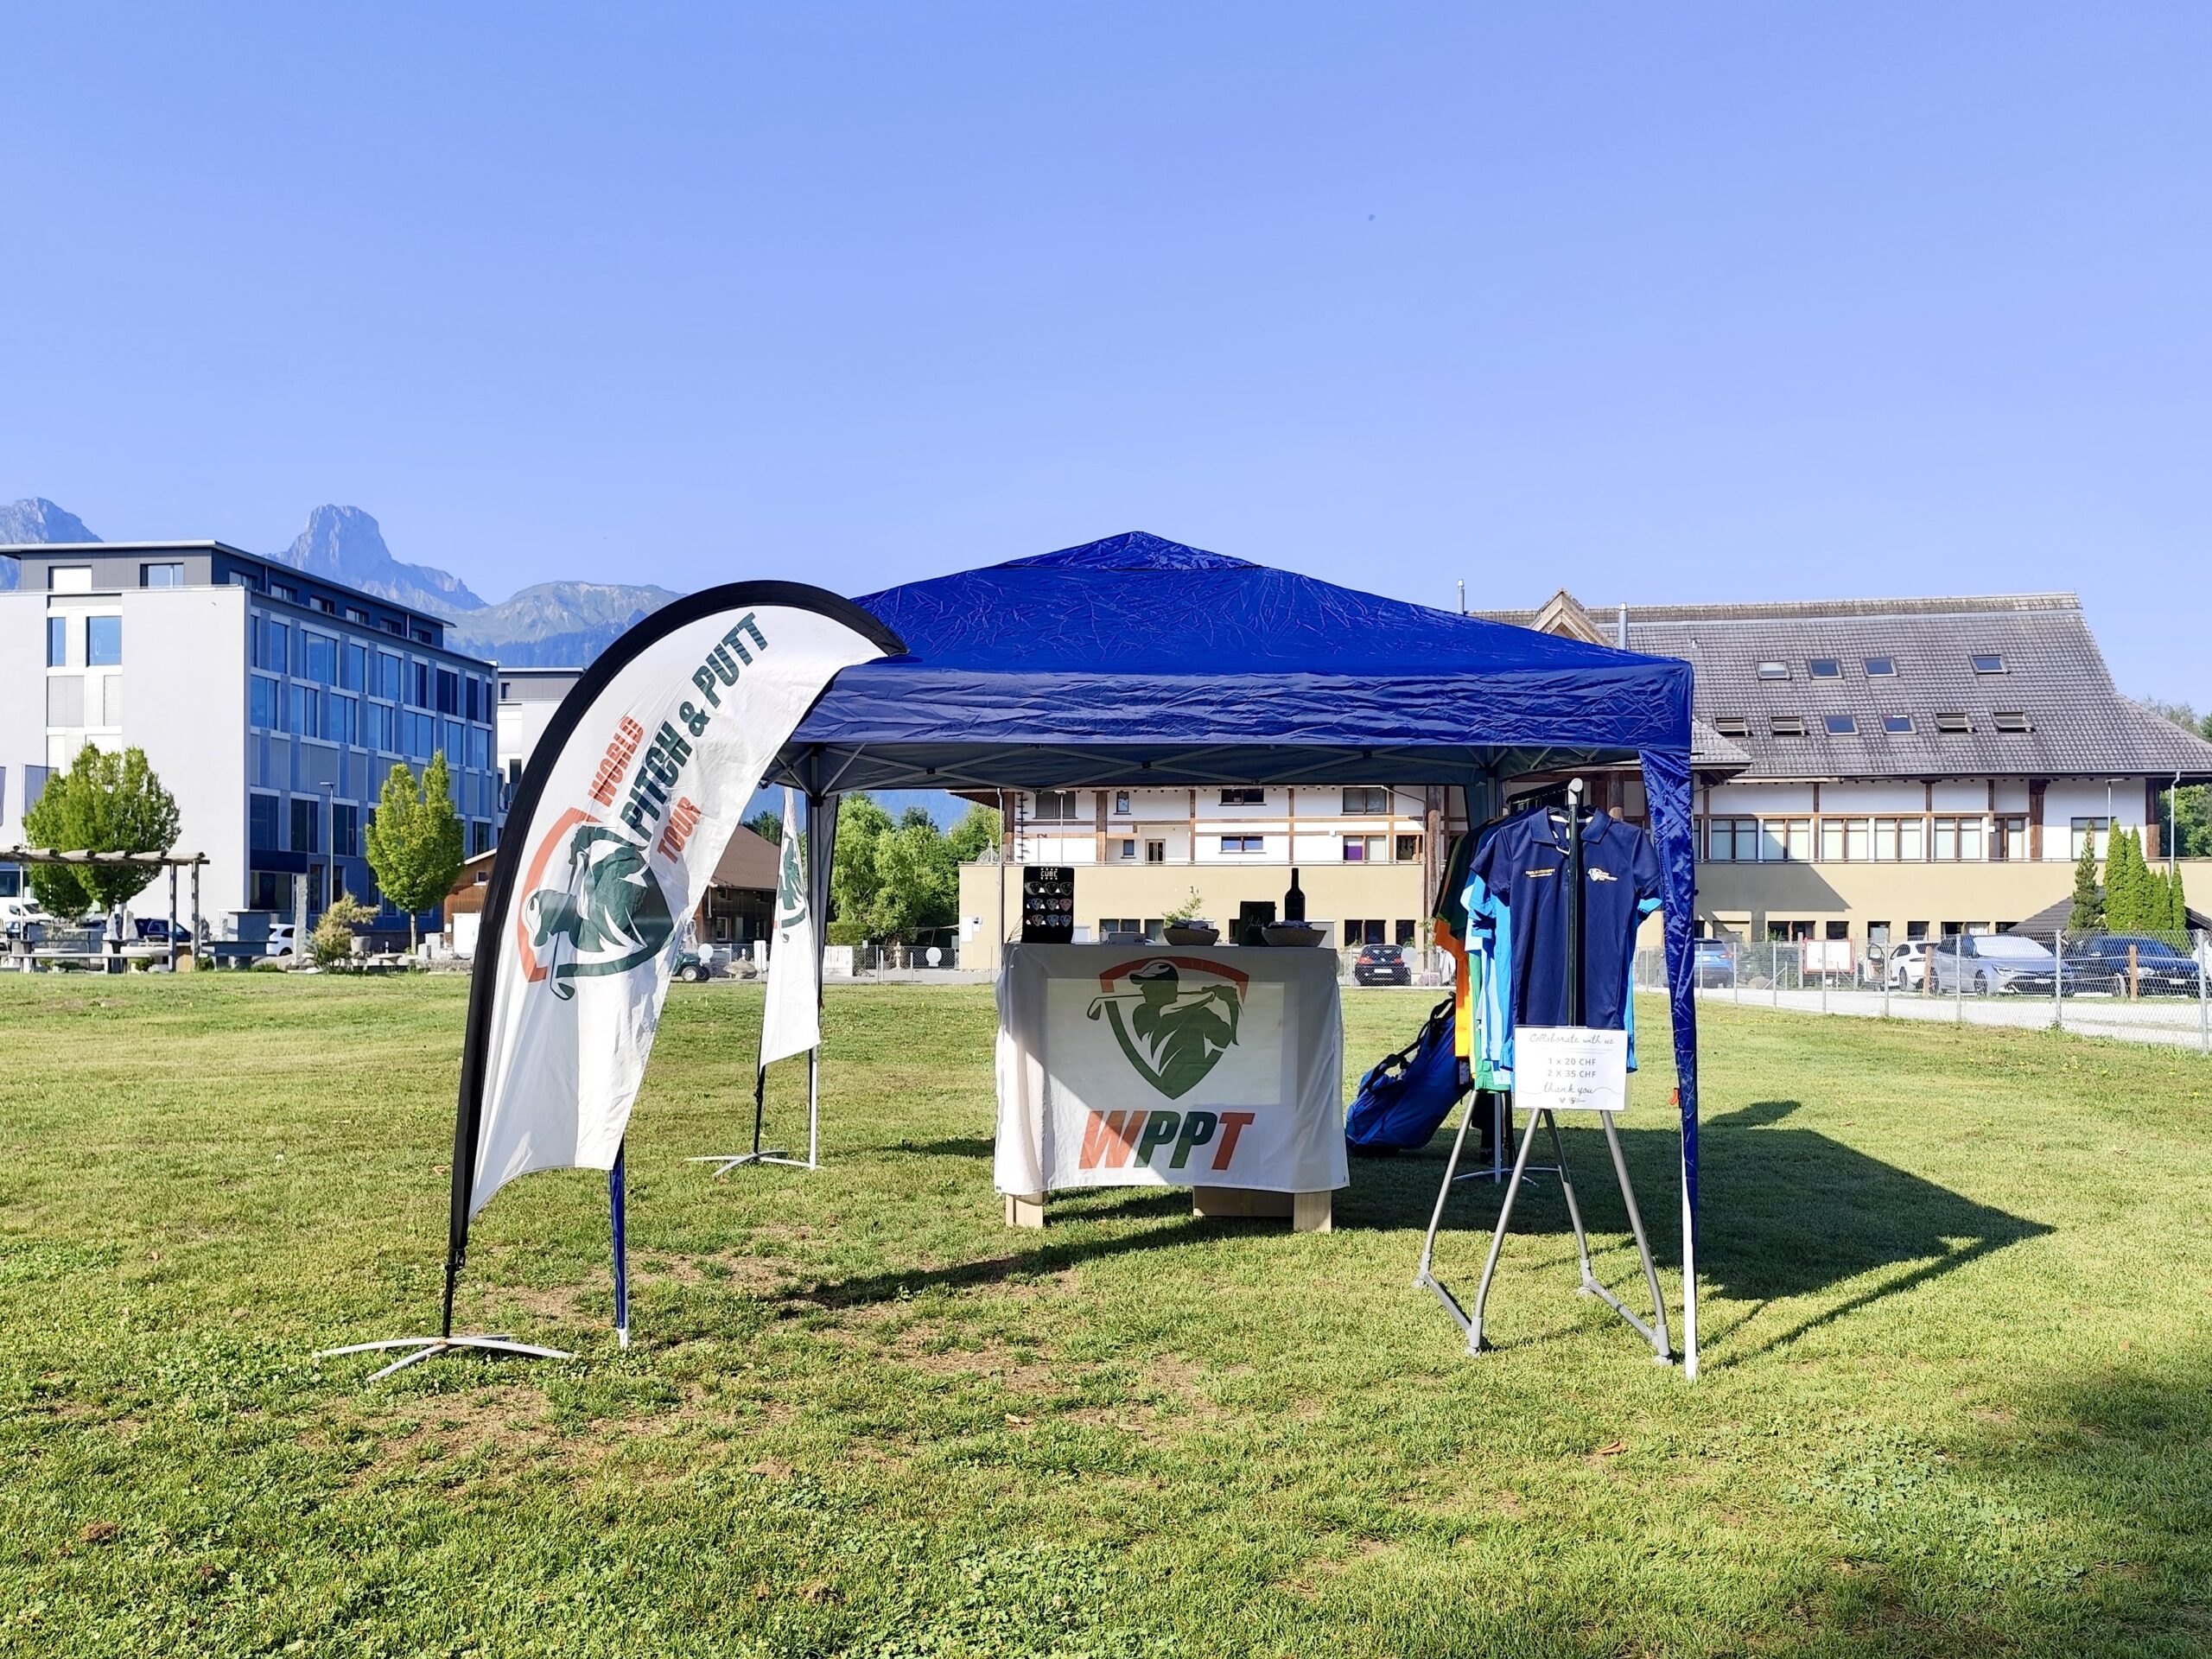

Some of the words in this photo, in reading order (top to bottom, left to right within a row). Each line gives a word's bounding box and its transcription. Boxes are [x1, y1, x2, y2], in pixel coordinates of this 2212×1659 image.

[691, 612, 768, 709] PUTT
[678, 701, 711, 737] &
[588, 715, 645, 807] WORLD
[620, 721, 693, 842] PITCH
[657, 796, 702, 864] TOUR
[1529, 1033, 1580, 1044] Collaborate
[1582, 1034, 1602, 1045] with
[1543, 1082, 1575, 1094] thank
[1577, 1087, 1593, 1096] you
[1078, 1110, 1255, 1170] WPPT
